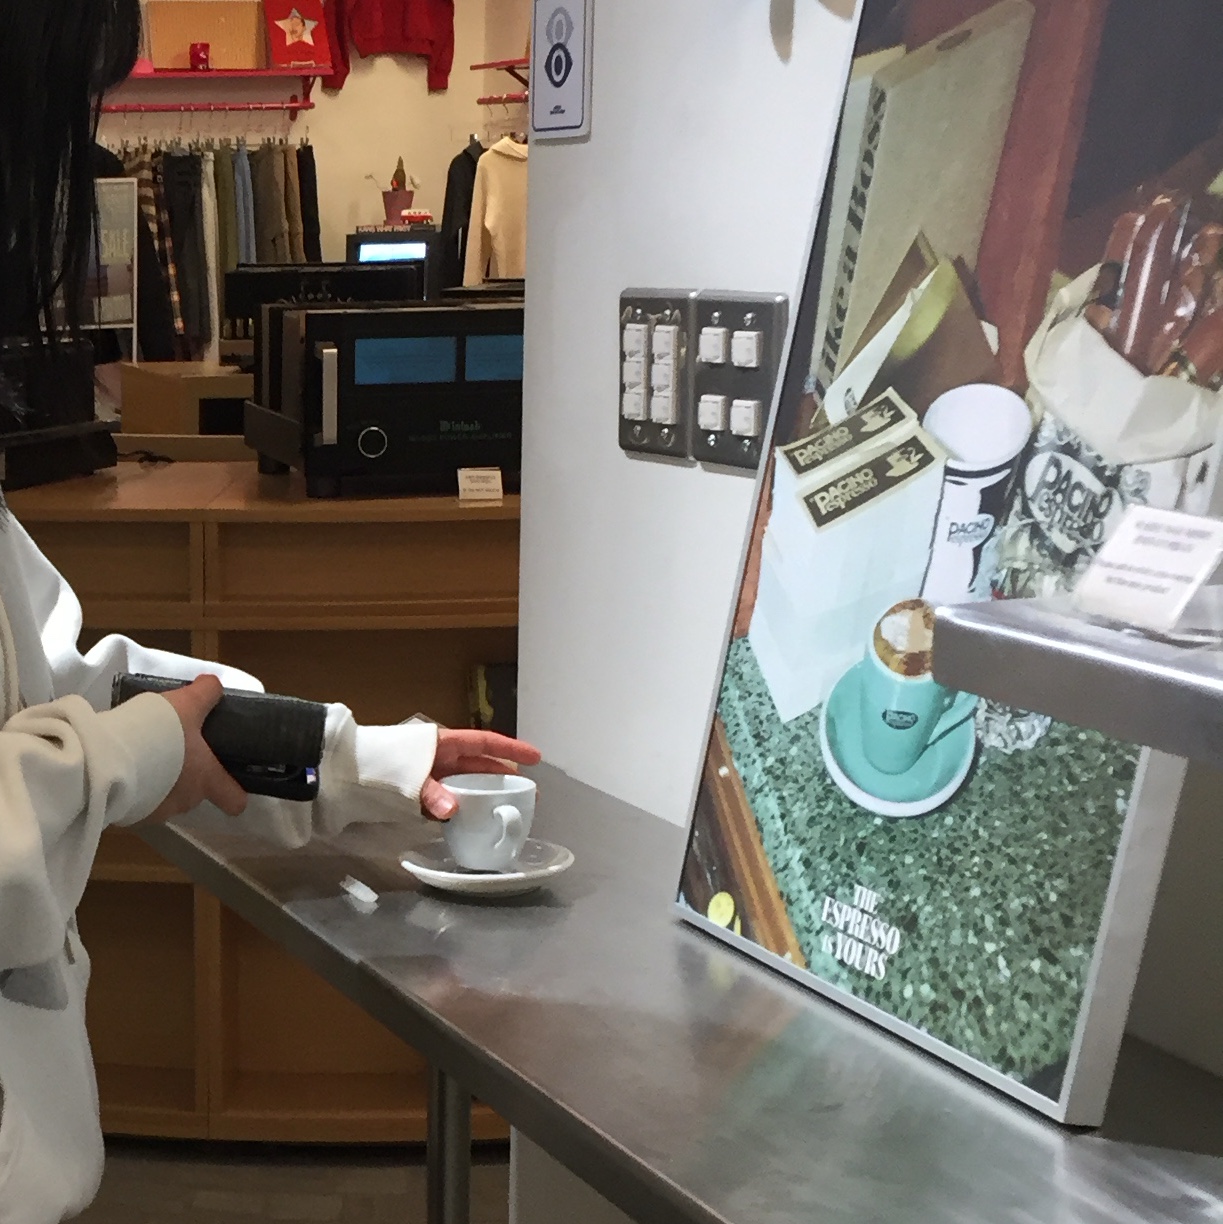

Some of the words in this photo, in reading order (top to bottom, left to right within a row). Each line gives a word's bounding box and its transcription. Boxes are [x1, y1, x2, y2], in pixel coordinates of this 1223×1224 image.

[812, 468, 874, 516] PACINO
[1031, 453, 1113, 520] PACINO
[853, 884, 885, 914] THE
[821, 895, 900, 955] ESPRESSO
[835, 931, 888, 981] YOURS
